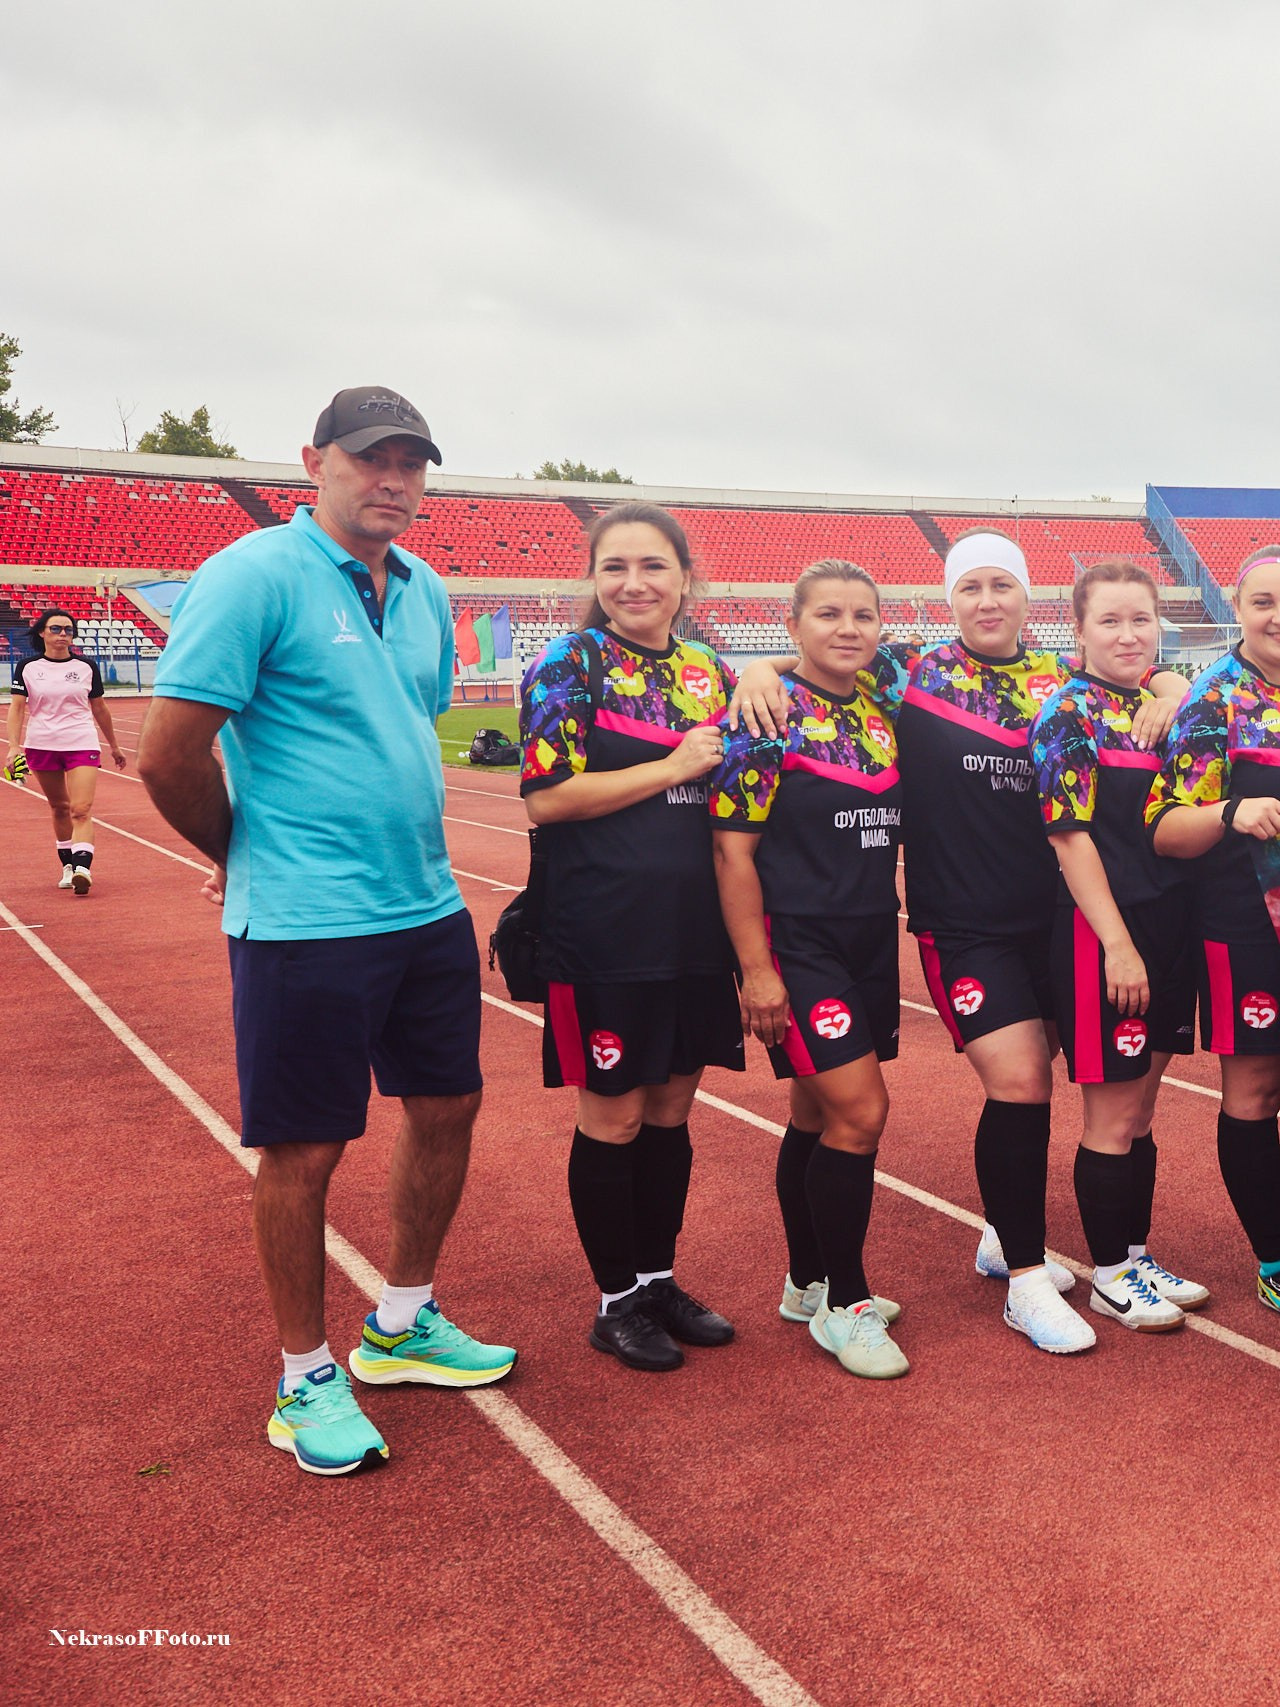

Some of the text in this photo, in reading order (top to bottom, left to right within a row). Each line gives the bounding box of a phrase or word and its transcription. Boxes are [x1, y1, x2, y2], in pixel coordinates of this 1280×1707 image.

[685, 677, 711, 699] 52
[963, 754, 1035, 776] ФУТБОЛЬ
[953, 990, 984, 1016] 52
[815, 1012, 852, 1039] 52
[1243, 1007, 1276, 1029] 52
[592, 1044, 621, 1070] 52
[1116, 1034, 1146, 1057] 52
